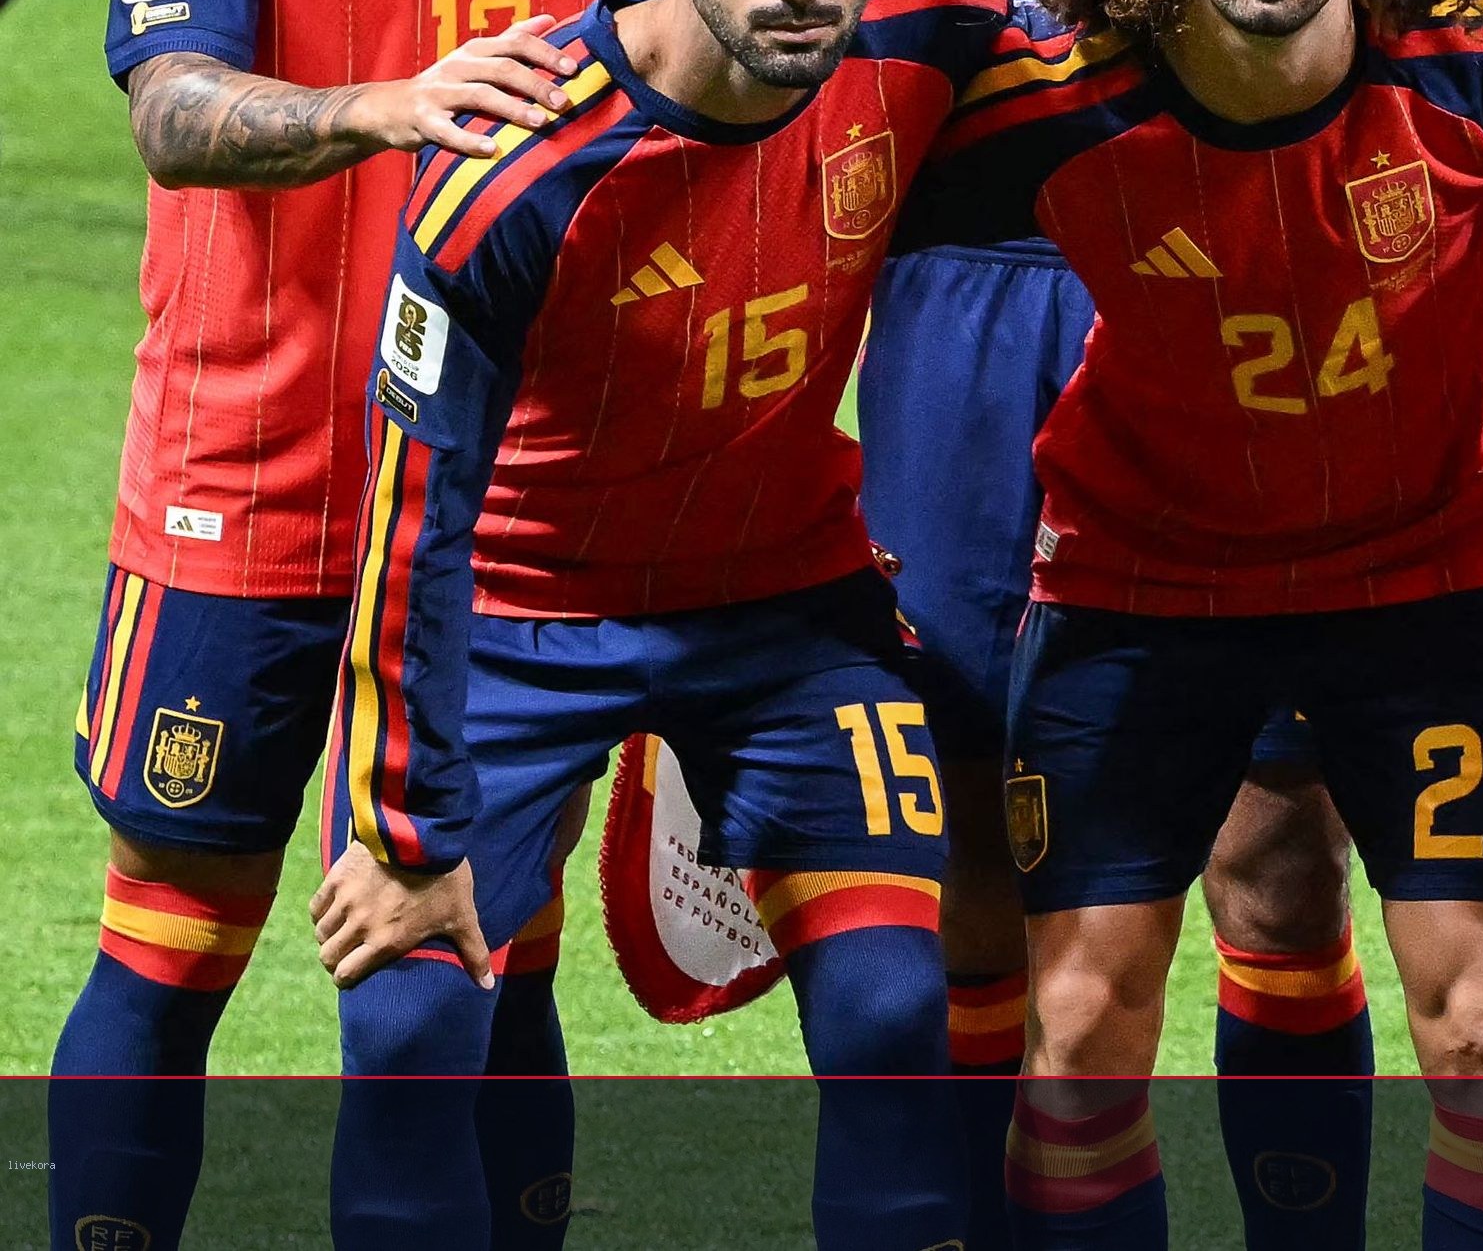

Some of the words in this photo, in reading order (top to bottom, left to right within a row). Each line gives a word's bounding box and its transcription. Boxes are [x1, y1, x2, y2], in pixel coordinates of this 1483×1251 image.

[386, 386, 413, 411] DEBUT
[703, 284, 809, 409] 15
[1221, 296, 1395, 415] 24
[835, 702, 944, 837] 15
[663, 887, 686, 910] DE
[691, 905, 762, 957] FÚTBOL
